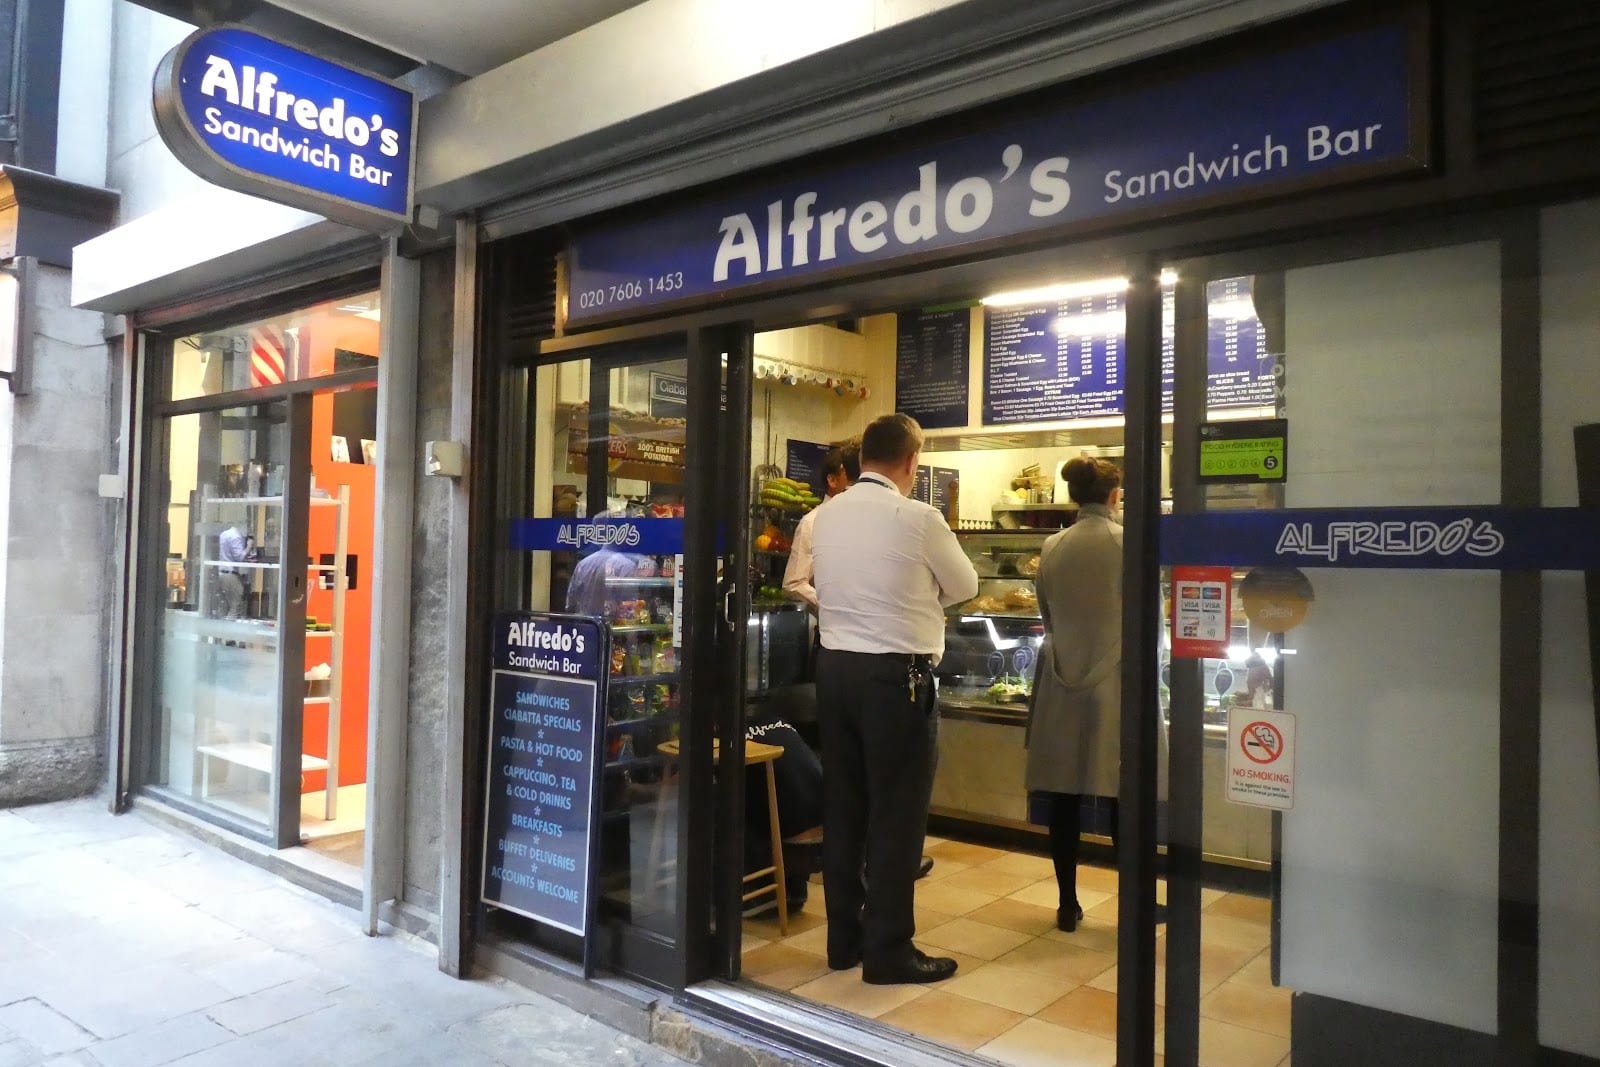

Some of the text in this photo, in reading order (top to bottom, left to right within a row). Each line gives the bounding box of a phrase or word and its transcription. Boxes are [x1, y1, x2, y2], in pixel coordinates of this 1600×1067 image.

[201, 54, 399, 157] Alfredo's
[204, 107, 392, 187] Sandwich Bar
[1104, 123, 1382, 203] Sandwich Bar
[713, 143, 1071, 283] Alfredo's
[580, 271, 683, 309] 020 7606 1453
[507, 621, 585, 653] Alfredo's
[508, 651, 581, 674] Sandwich Bar
[516, 691, 570, 711] SANDWICHES
[504, 708, 581, 732] CIABATTA SPECIALS
[501, 736, 583, 762] PASTA & HOT FOOD
[561, 777, 576, 792] TEA
[1232, 768, 1246, 777] NO
[506, 784, 572, 810] & COLD DRINKS
[512, 813, 563, 838] BREAKFASTS
[499, 838, 576, 872] BUFFET DELIVERIES
[491, 866, 579, 903] ACCOUNTS WELCOME
